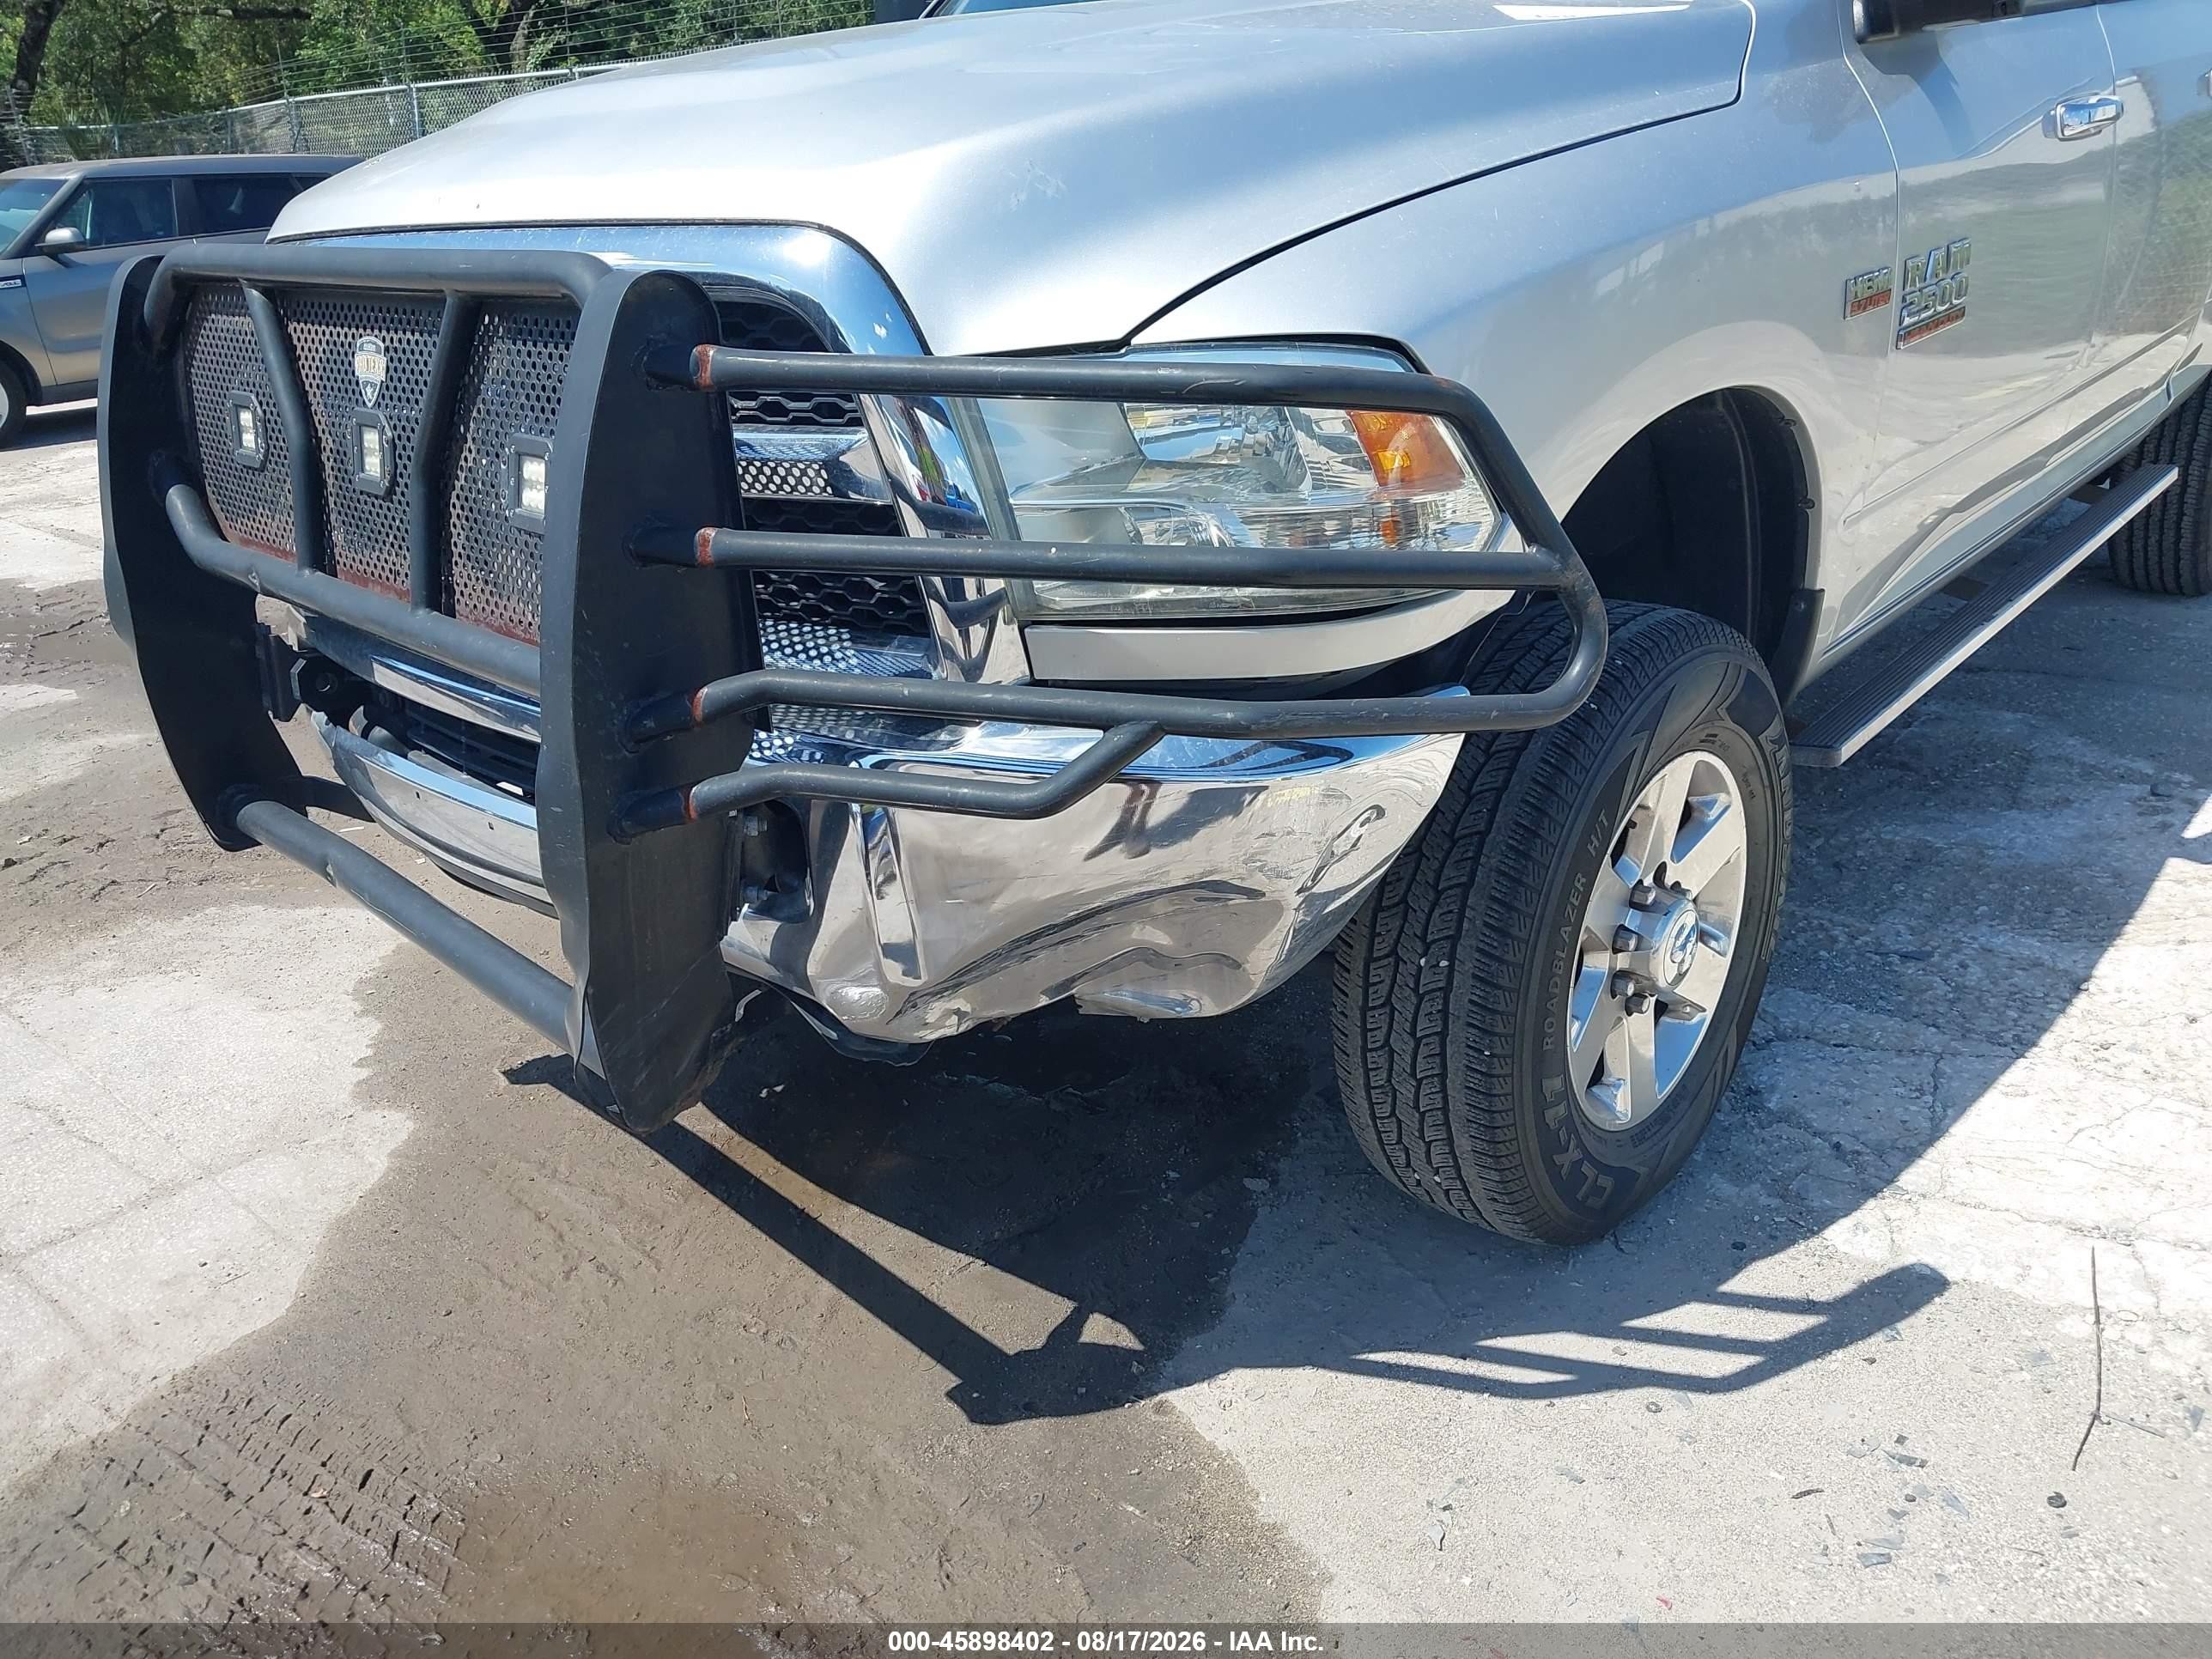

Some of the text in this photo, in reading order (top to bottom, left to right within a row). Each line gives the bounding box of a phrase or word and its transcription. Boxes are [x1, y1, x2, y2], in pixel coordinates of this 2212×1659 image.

[1846, 266, 1892, 301] HEMI
[1903, 237, 1972, 292] RAM
[1900, 270, 1969, 326] 2500
[1542, 808, 1609, 1051] ROADBLAZER H/T
[1541, 1074, 1615, 1209] CLX-11
